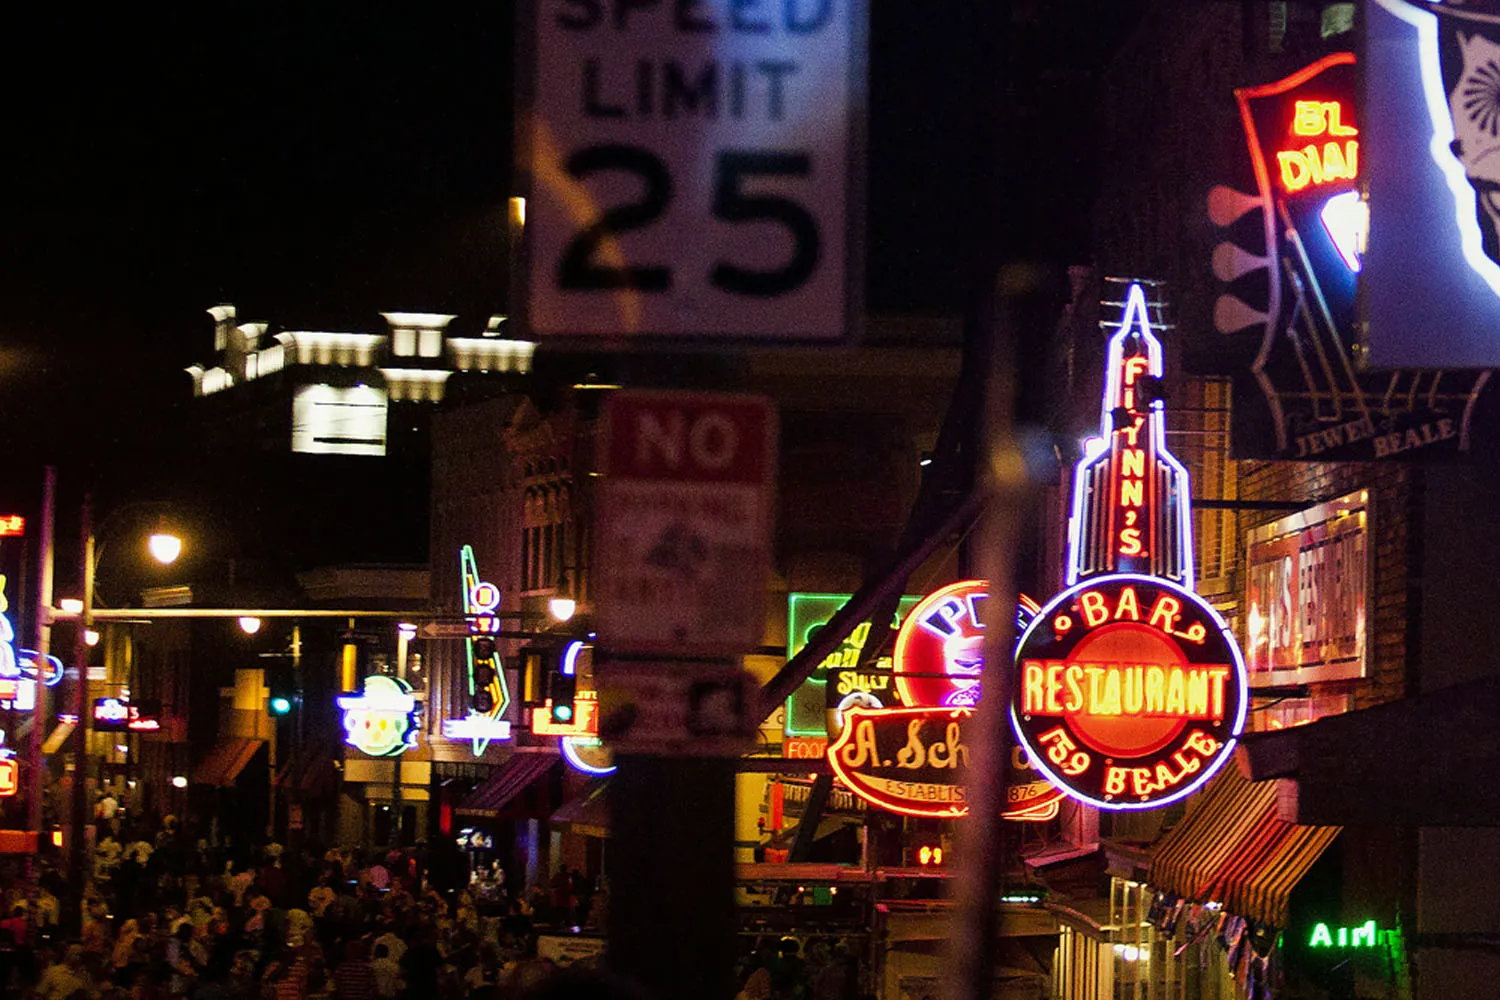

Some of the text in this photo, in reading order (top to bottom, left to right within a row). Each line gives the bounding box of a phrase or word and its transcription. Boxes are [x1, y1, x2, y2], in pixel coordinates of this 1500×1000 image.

[582, 59, 799, 122] LIMIT
[558, 145, 820, 297] 25
[637, 412, 739, 468] NO
[1373, 418, 1457, 458] BEALE
[1081, 587, 1181, 633] BAR
[1024, 664, 1229, 716] RESTAURANT
[842, 719, 891, 768] A.
[1038, 728, 1218, 795] 159 BEALE
[885, 780, 1037, 801] ESTABLIS 876
